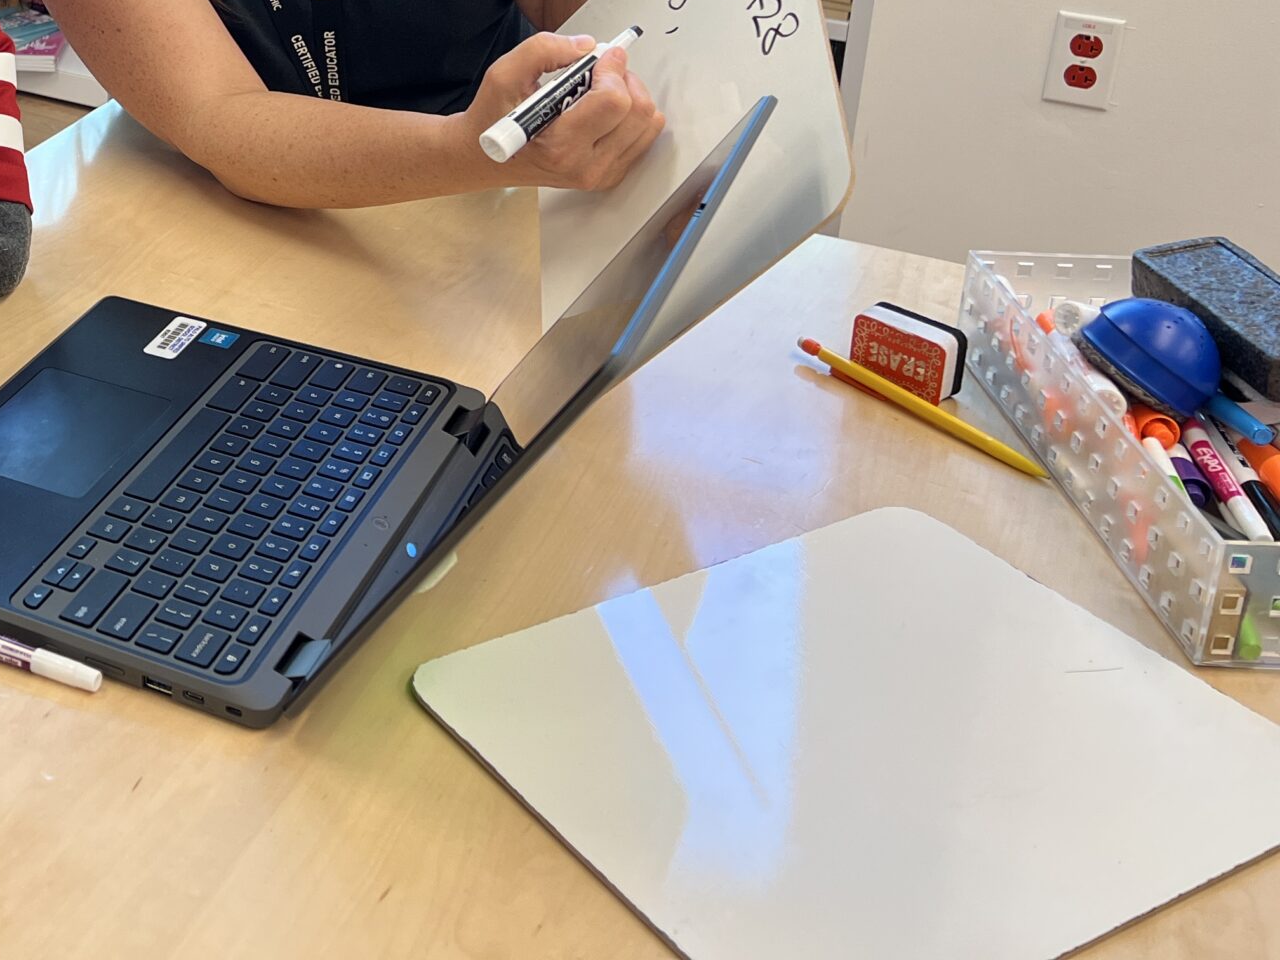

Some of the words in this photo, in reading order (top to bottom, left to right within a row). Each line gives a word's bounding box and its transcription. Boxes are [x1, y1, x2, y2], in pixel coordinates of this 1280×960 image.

[291, 34, 322, 88] CERTIFIED
[323, 31, 340, 86] EDUCATOR
[869, 341, 926, 383] ERASE
[1196, 447, 1223, 472] EXPO
